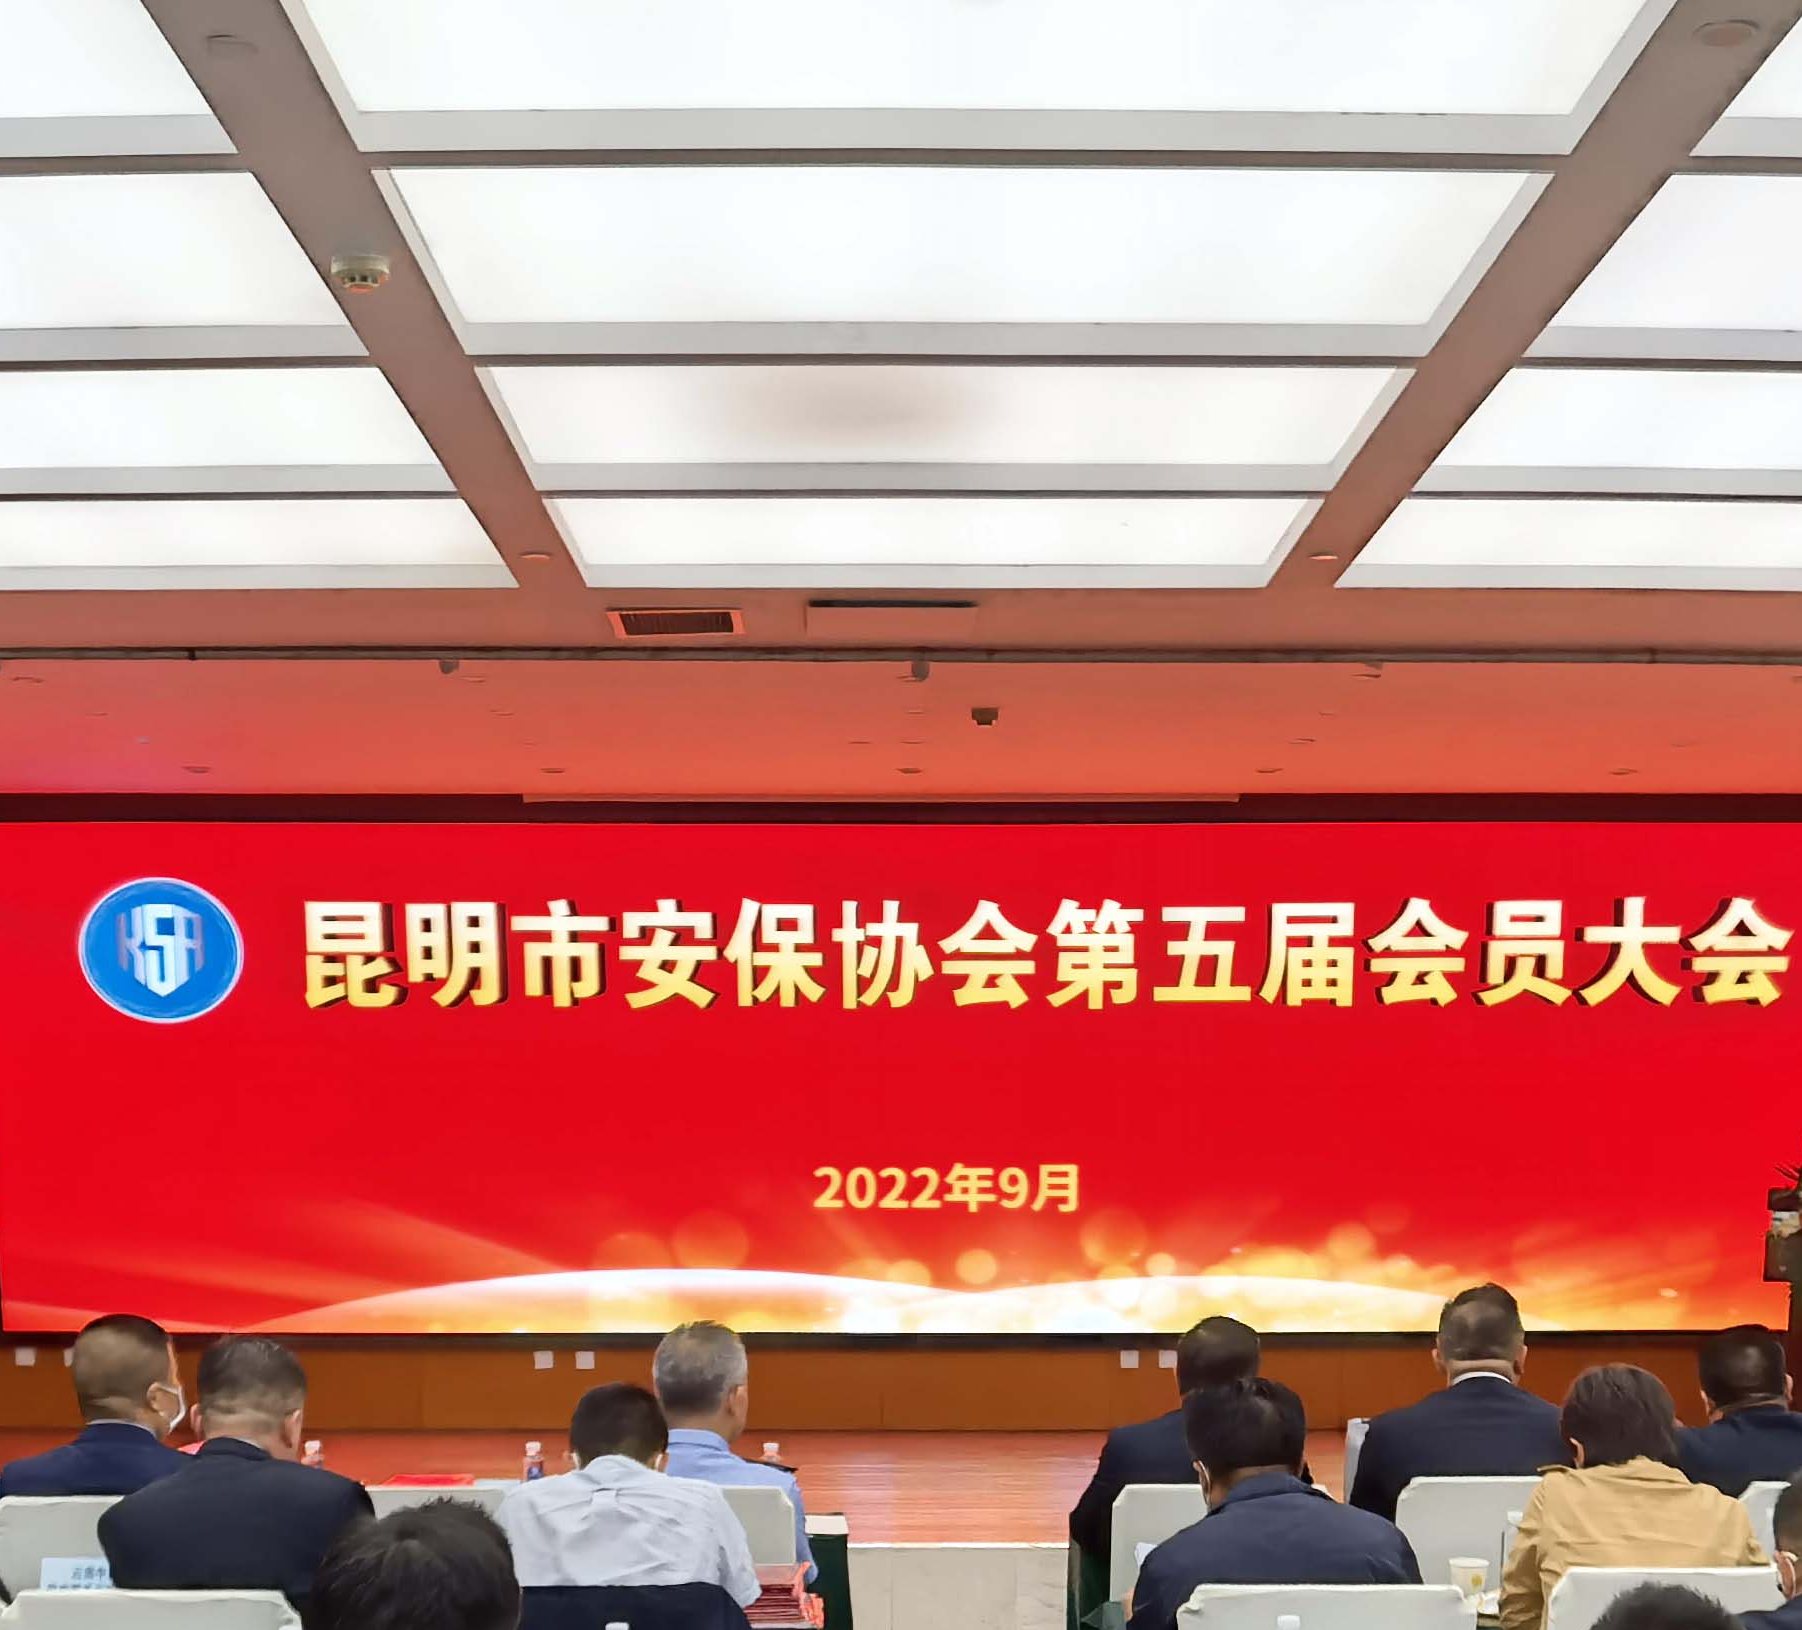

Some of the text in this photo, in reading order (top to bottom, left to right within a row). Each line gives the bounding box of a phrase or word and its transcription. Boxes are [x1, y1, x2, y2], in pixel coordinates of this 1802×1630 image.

[302, 896, 1794, 1009] 昆明市安保协会第五届会员大会
[812, 1162, 1080, 1212] 2022年9月
